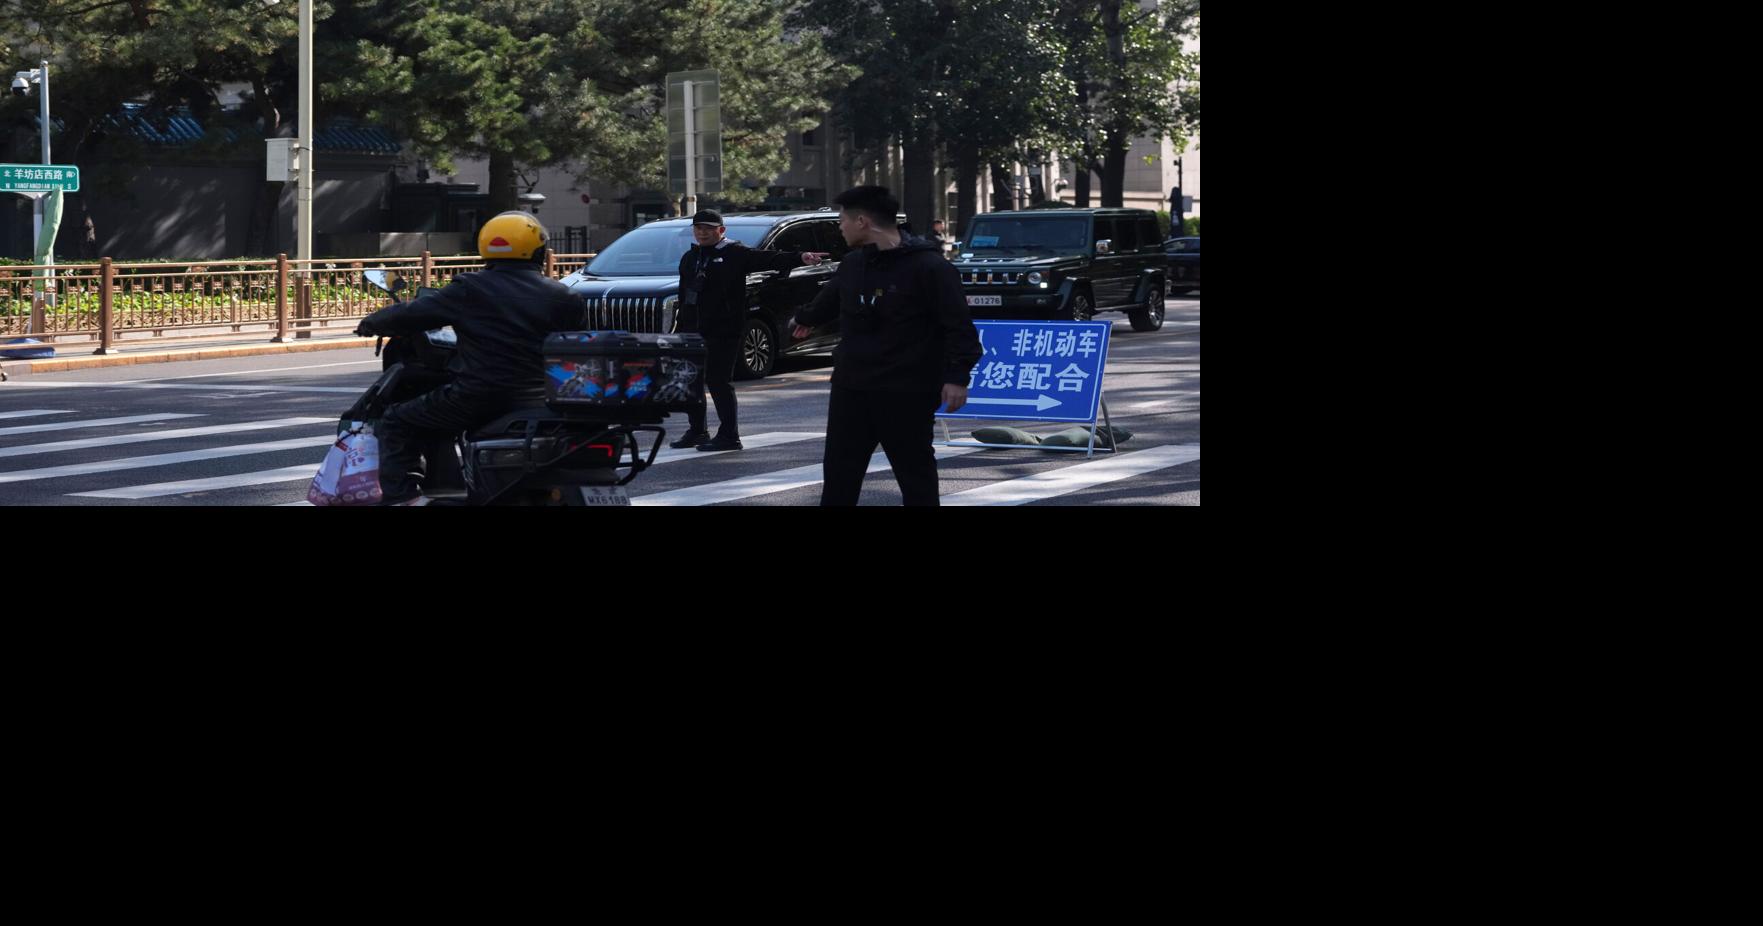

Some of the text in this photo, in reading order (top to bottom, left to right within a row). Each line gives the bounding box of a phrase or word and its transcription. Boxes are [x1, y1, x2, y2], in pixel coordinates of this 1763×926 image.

[14, 169, 63, 180] 羊坊店西路
